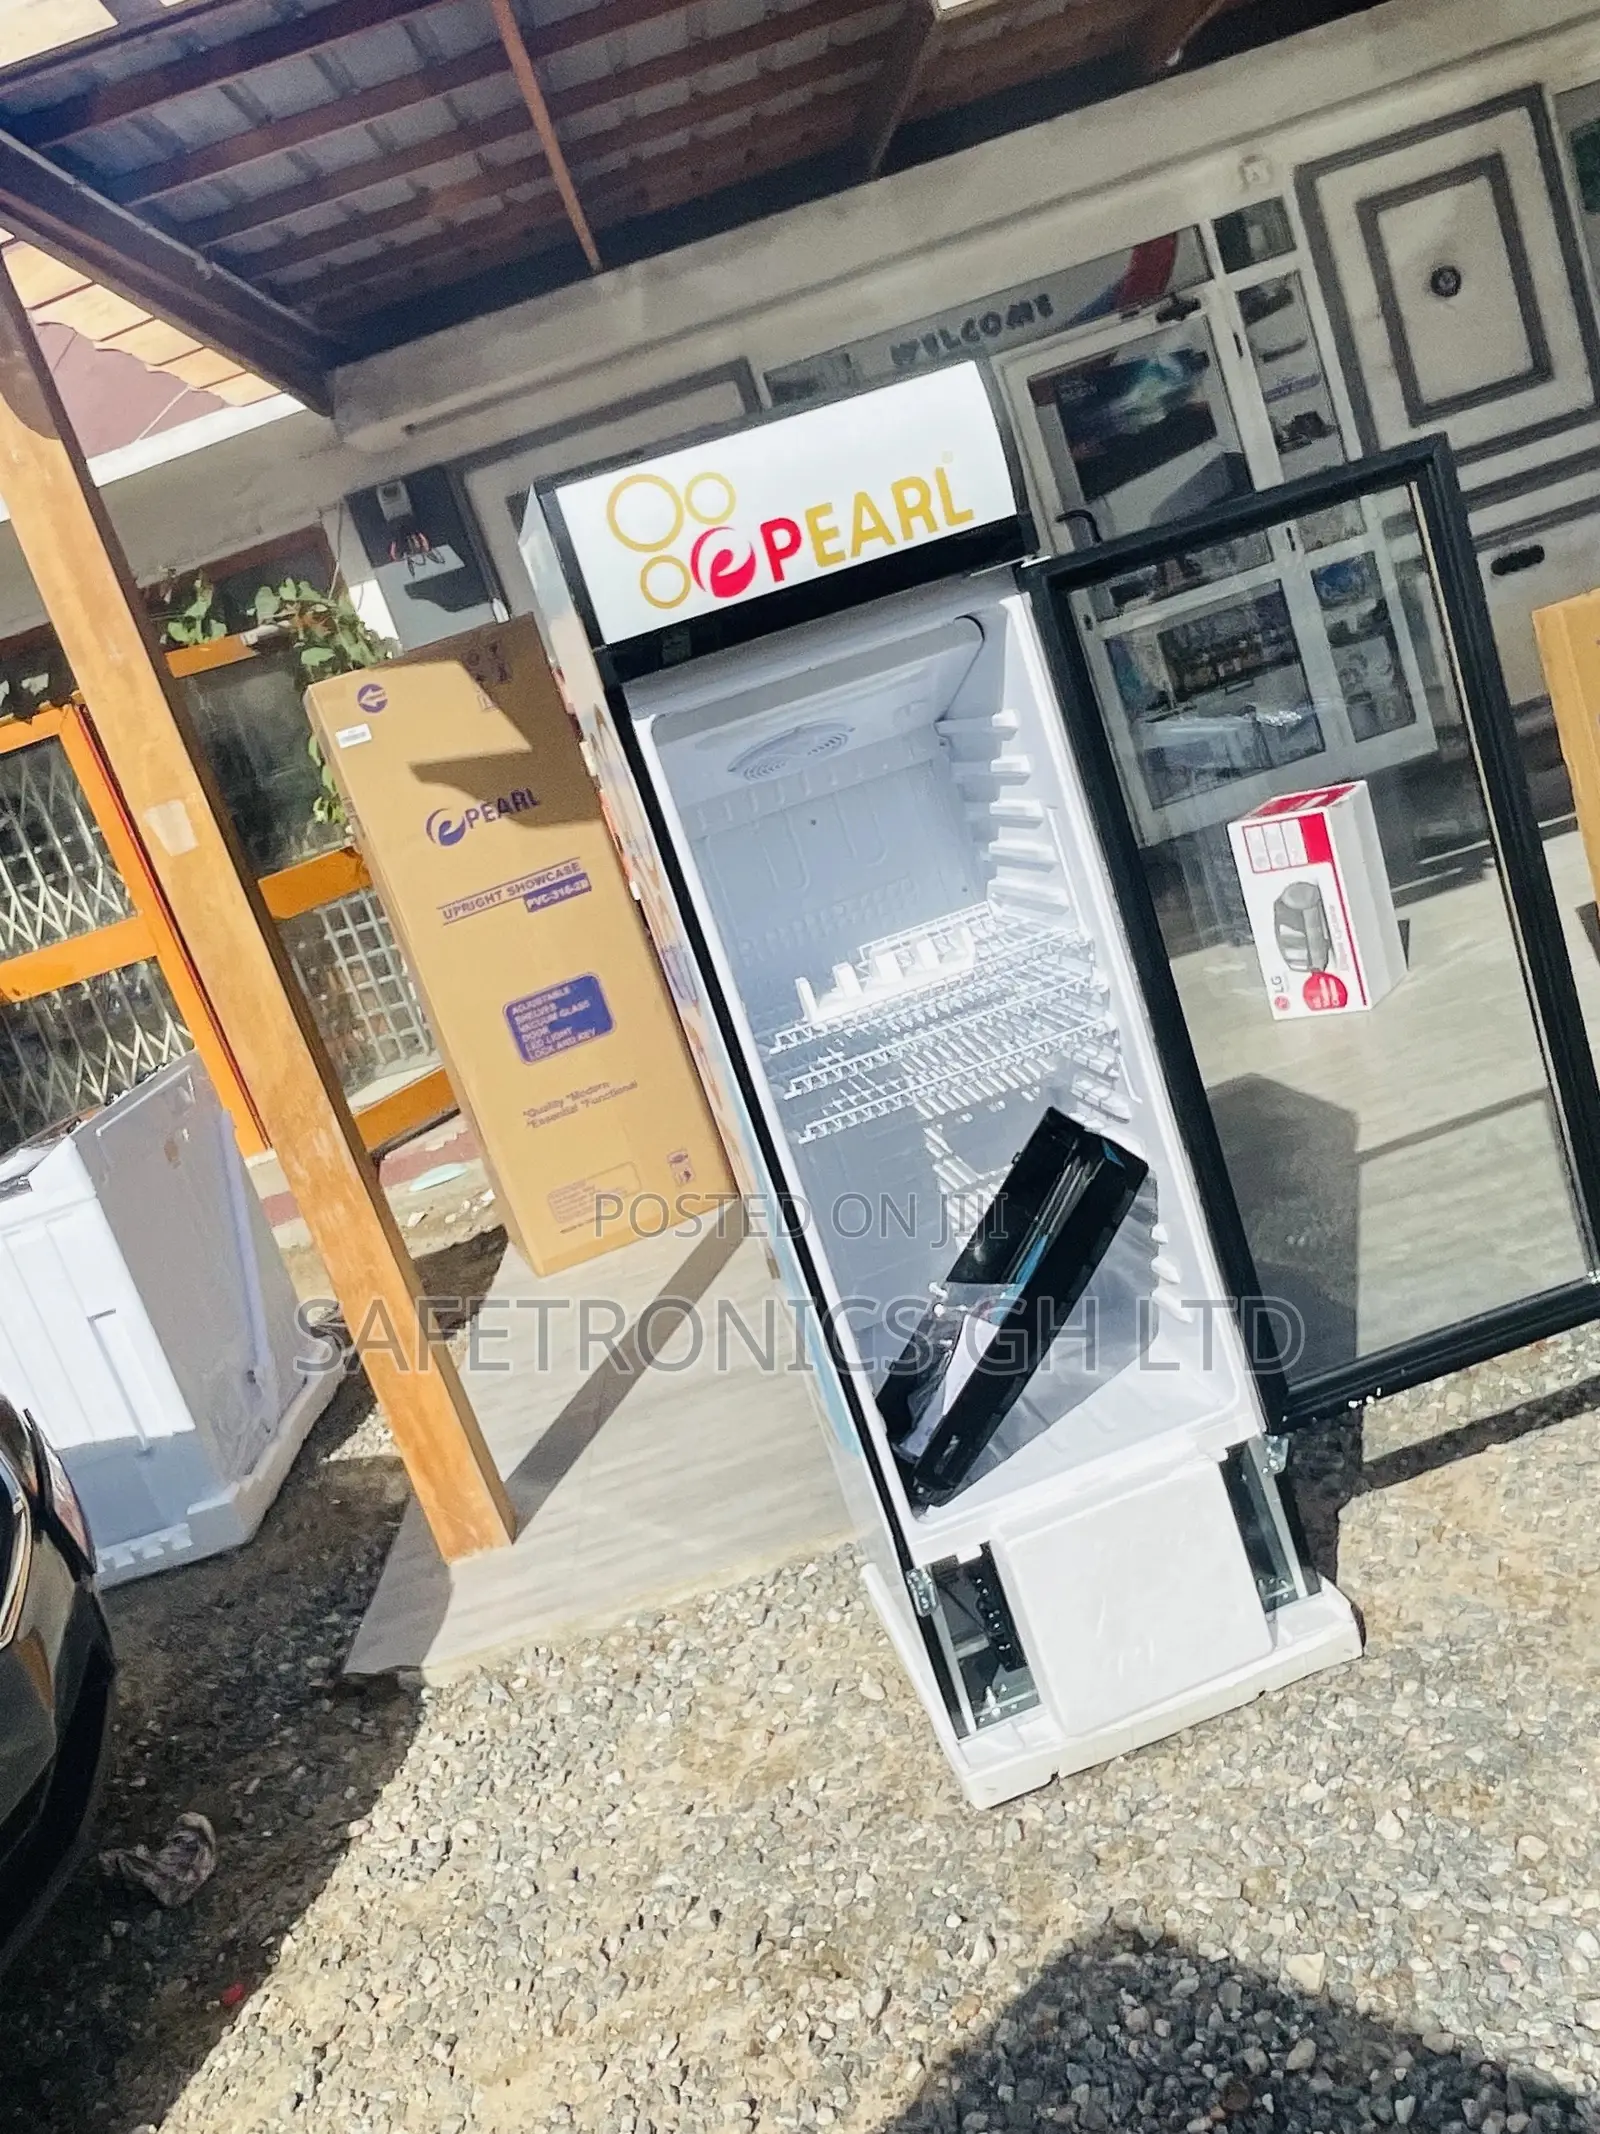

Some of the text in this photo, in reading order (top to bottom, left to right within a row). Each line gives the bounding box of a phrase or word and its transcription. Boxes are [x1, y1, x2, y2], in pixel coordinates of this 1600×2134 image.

[759, 466, 974, 583] PEARL
[464, 788, 540, 829] PEARL
[442, 861, 581, 921] UPRIGHT SHOWCASE
